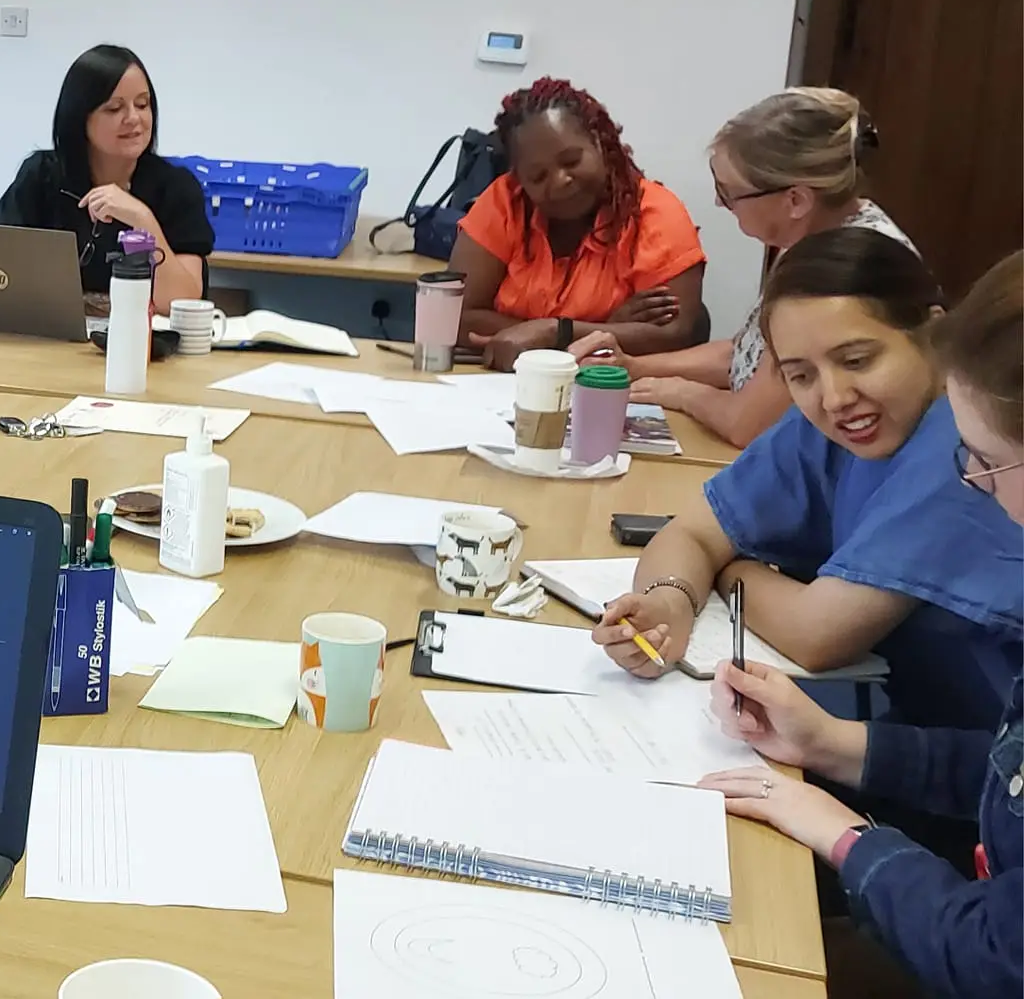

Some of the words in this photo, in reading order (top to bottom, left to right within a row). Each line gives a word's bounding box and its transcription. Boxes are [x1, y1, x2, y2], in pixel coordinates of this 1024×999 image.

[92, 600, 106, 652] Stylostik
[78, 644, 88, 660] 50
[87, 654, 102, 686] WB
